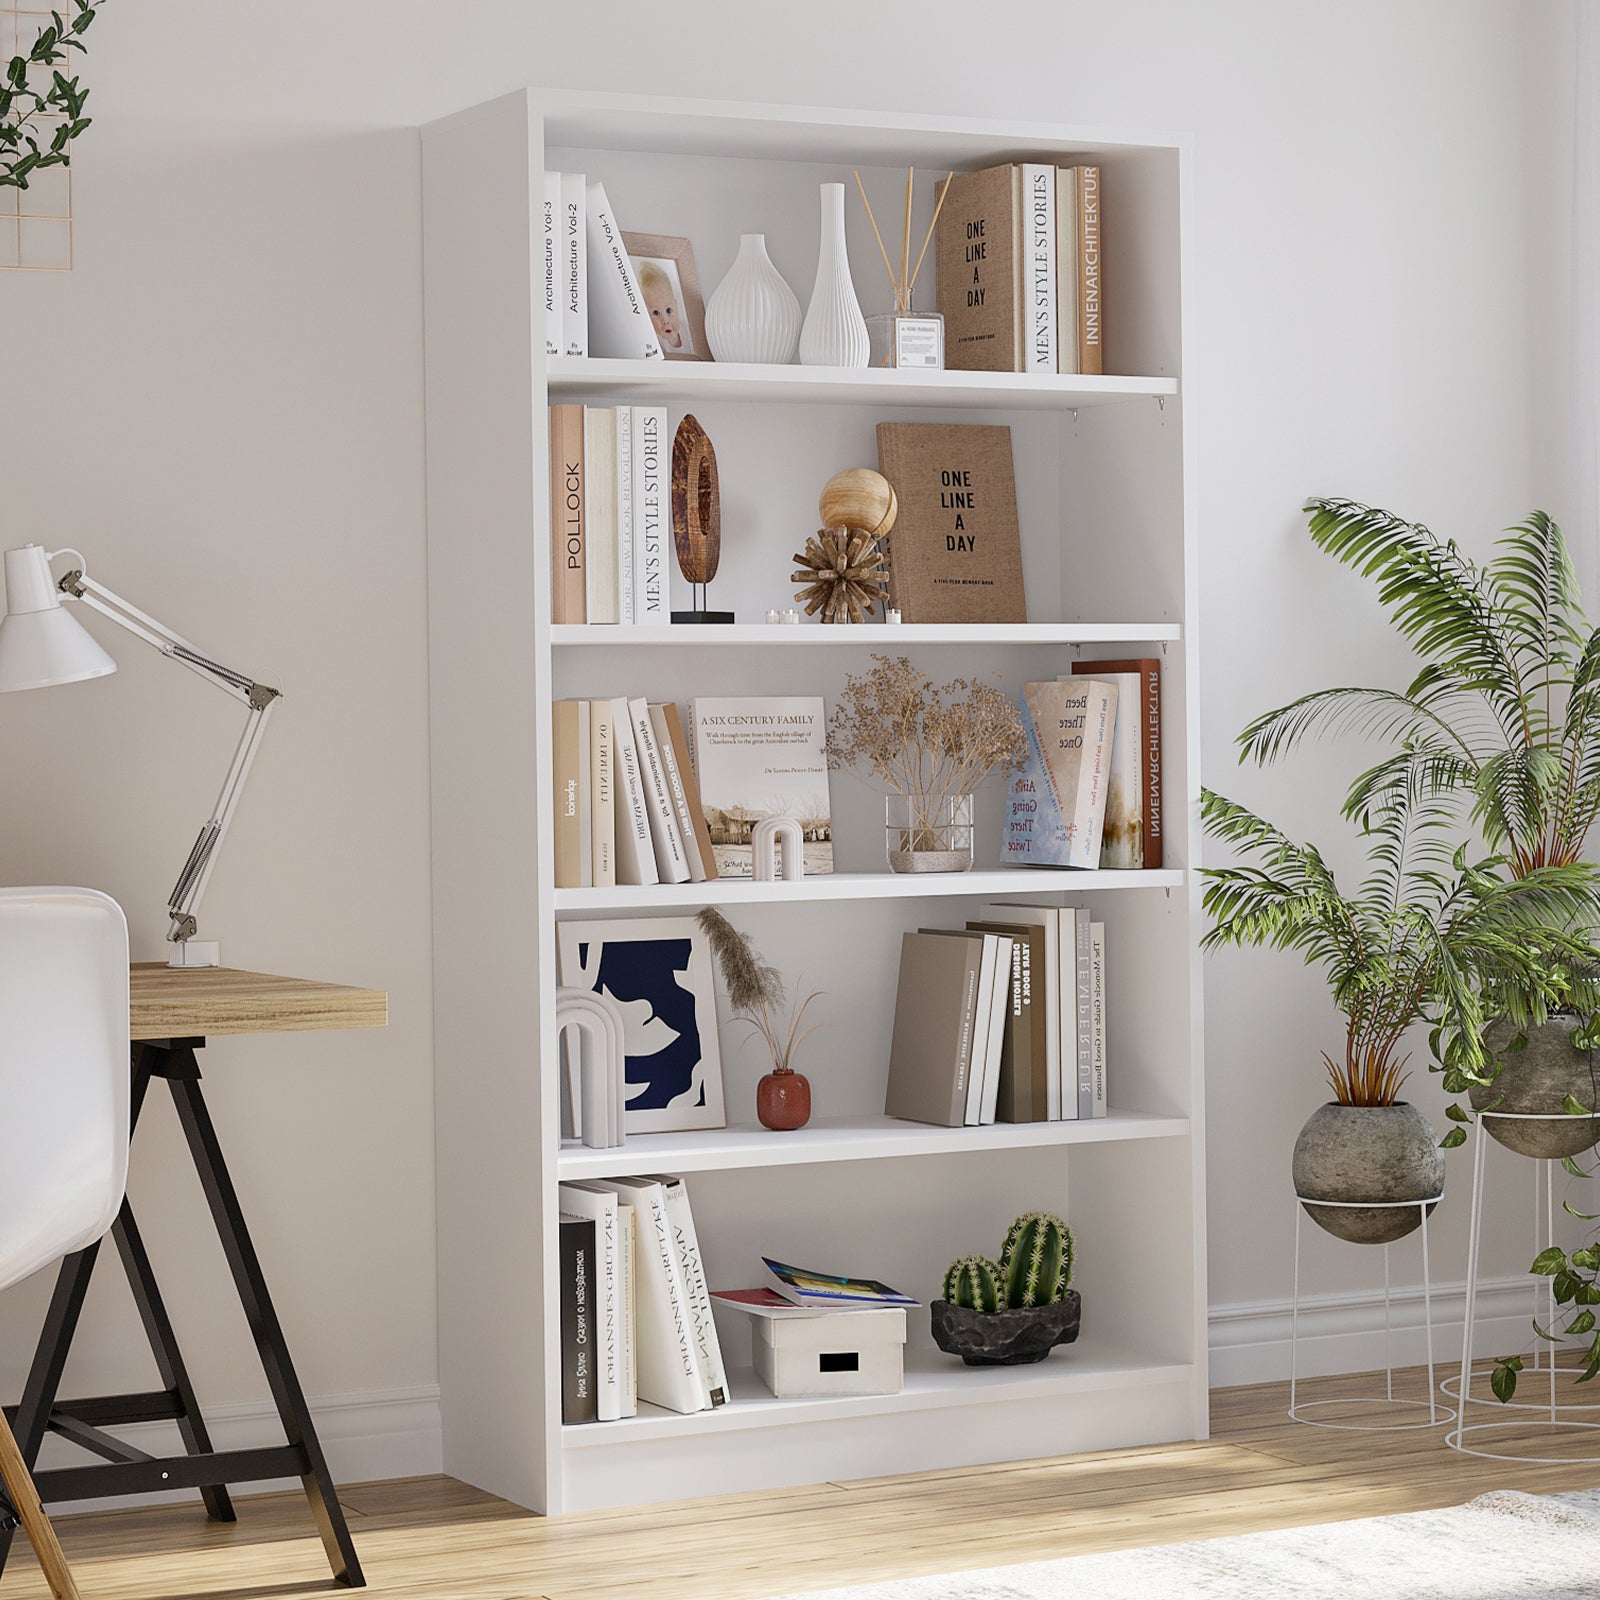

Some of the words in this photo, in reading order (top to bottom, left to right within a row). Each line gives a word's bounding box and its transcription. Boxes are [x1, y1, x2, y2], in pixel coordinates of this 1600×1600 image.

[544, 201, 553, 233] Vol-3
[568, 203, 577, 236] Vol-2
[598, 213, 614, 244] Vol-1
[967, 220, 985, 239] ONE
[1034, 174, 1047, 248] STORIES
[545, 238, 553, 311] Architecture
[966, 242, 986, 262] LINE
[1084, 167, 1098, 345] INNENARCHITEKTUR
[569, 240, 578, 313] Architecture
[612, 246, 641, 315] Architecture
[967, 288, 986, 307] DAY
[973, 267, 979, 284] A
[1035, 252, 1048, 307] STYLE
[1035, 311, 1049, 364] MEN'S
[622, 412, 630, 501] REVOLUTION
[644, 416, 659, 493] STORIES
[941, 470, 971, 487] ONE
[941, 492, 975, 509] LINE
[566, 462, 581, 569] POLLOCK
[623, 505, 631, 543] LOOK
[645, 497, 659, 553] STYLE
[955, 514, 965, 530] A
[624, 547, 632, 579] NEW
[946, 536, 976, 552] DAY
[646, 557, 660, 612] MEN'S
[710, 716, 726, 725] SIX
[727, 716, 776, 725] CENTURY
[777, 715, 814, 724] FAMILY
[606, 1293, 615, 1386] JOHANNES
[667, 1286, 694, 1377] JOHANNES
